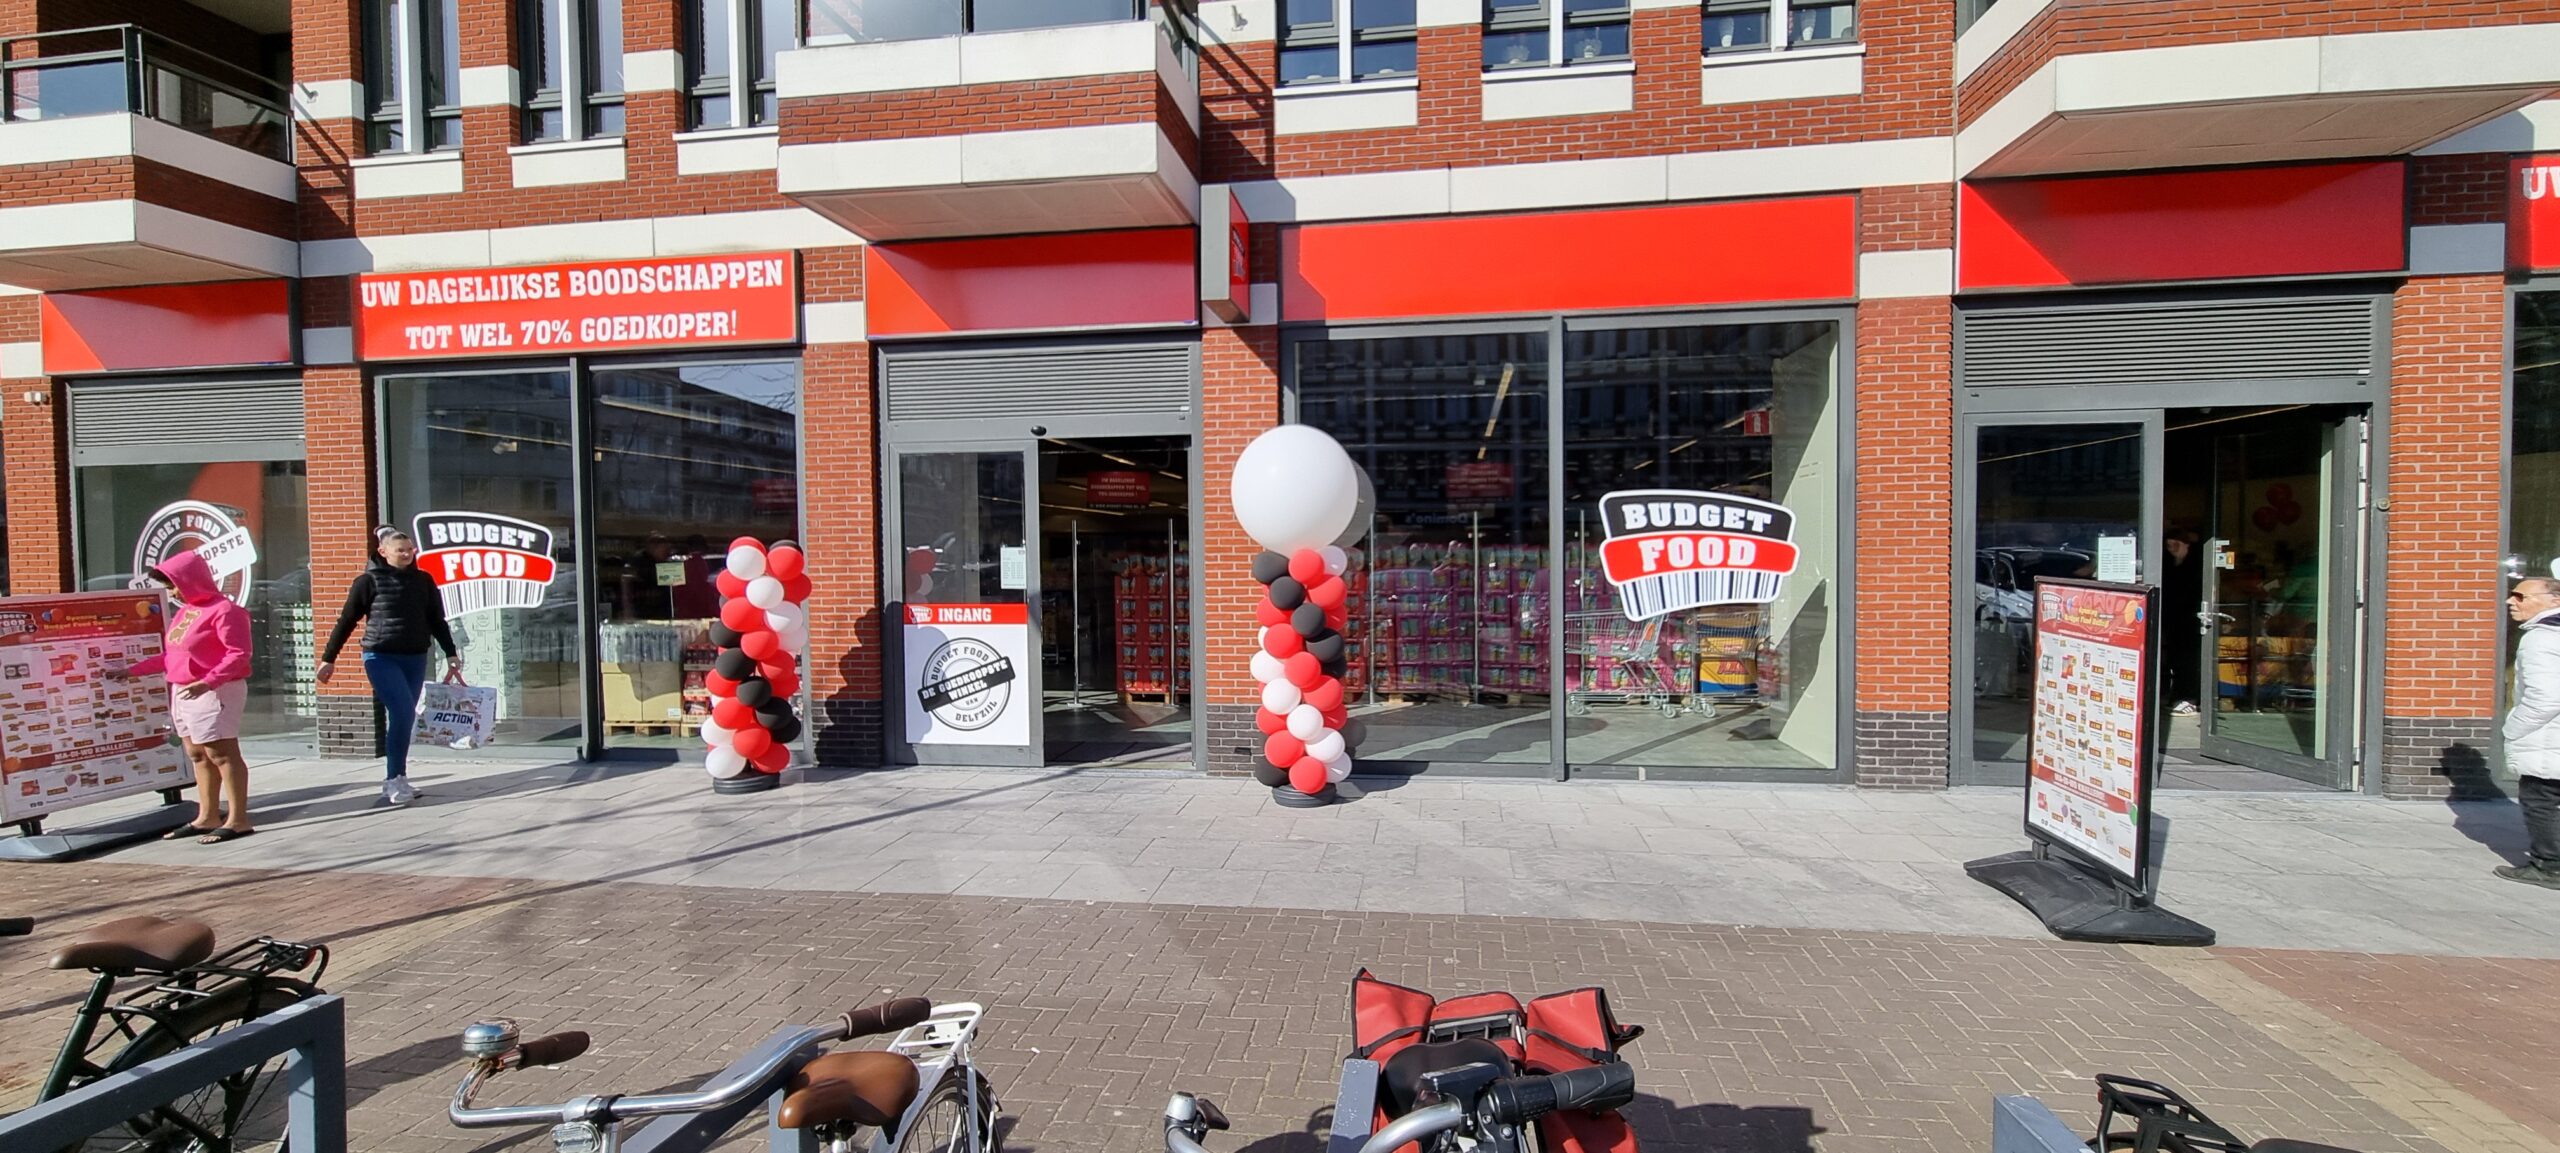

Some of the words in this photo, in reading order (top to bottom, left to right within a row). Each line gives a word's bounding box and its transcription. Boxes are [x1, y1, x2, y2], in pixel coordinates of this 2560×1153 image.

[361, 280, 400, 308] UW
[409, 271, 560, 306] DAGELIJKSE
[568, 259, 783, 298] BOODSCHAPPEN
[405, 324, 453, 351] TOT
[459, 322, 512, 348] WEL
[520, 318, 572, 346] 70%
[580, 310, 737, 343] GOEDKOPER!
[1621, 502, 1773, 534] BUDGET
[145, 516, 182, 568] BUDGET
[186, 514, 221, 538] FOOD
[428, 522, 536, 549] BUDGET
[441, 550, 526, 581] FOOD
[1637, 536, 1757, 573] FOOD
[938, 607, 992, 623] INGANG
[930, 648, 960, 681] BUDGET
[963, 646, 990, 662] FOOD
[921, 687, 936, 700] DE
[938, 659, 1009, 694] GOEDKOOPSTE
[947, 680, 988, 701] WINKEL
[955, 700, 998, 723] DELFZIJL
[965, 698, 979, 706] VAN
[433, 712, 474, 725] ACTION
